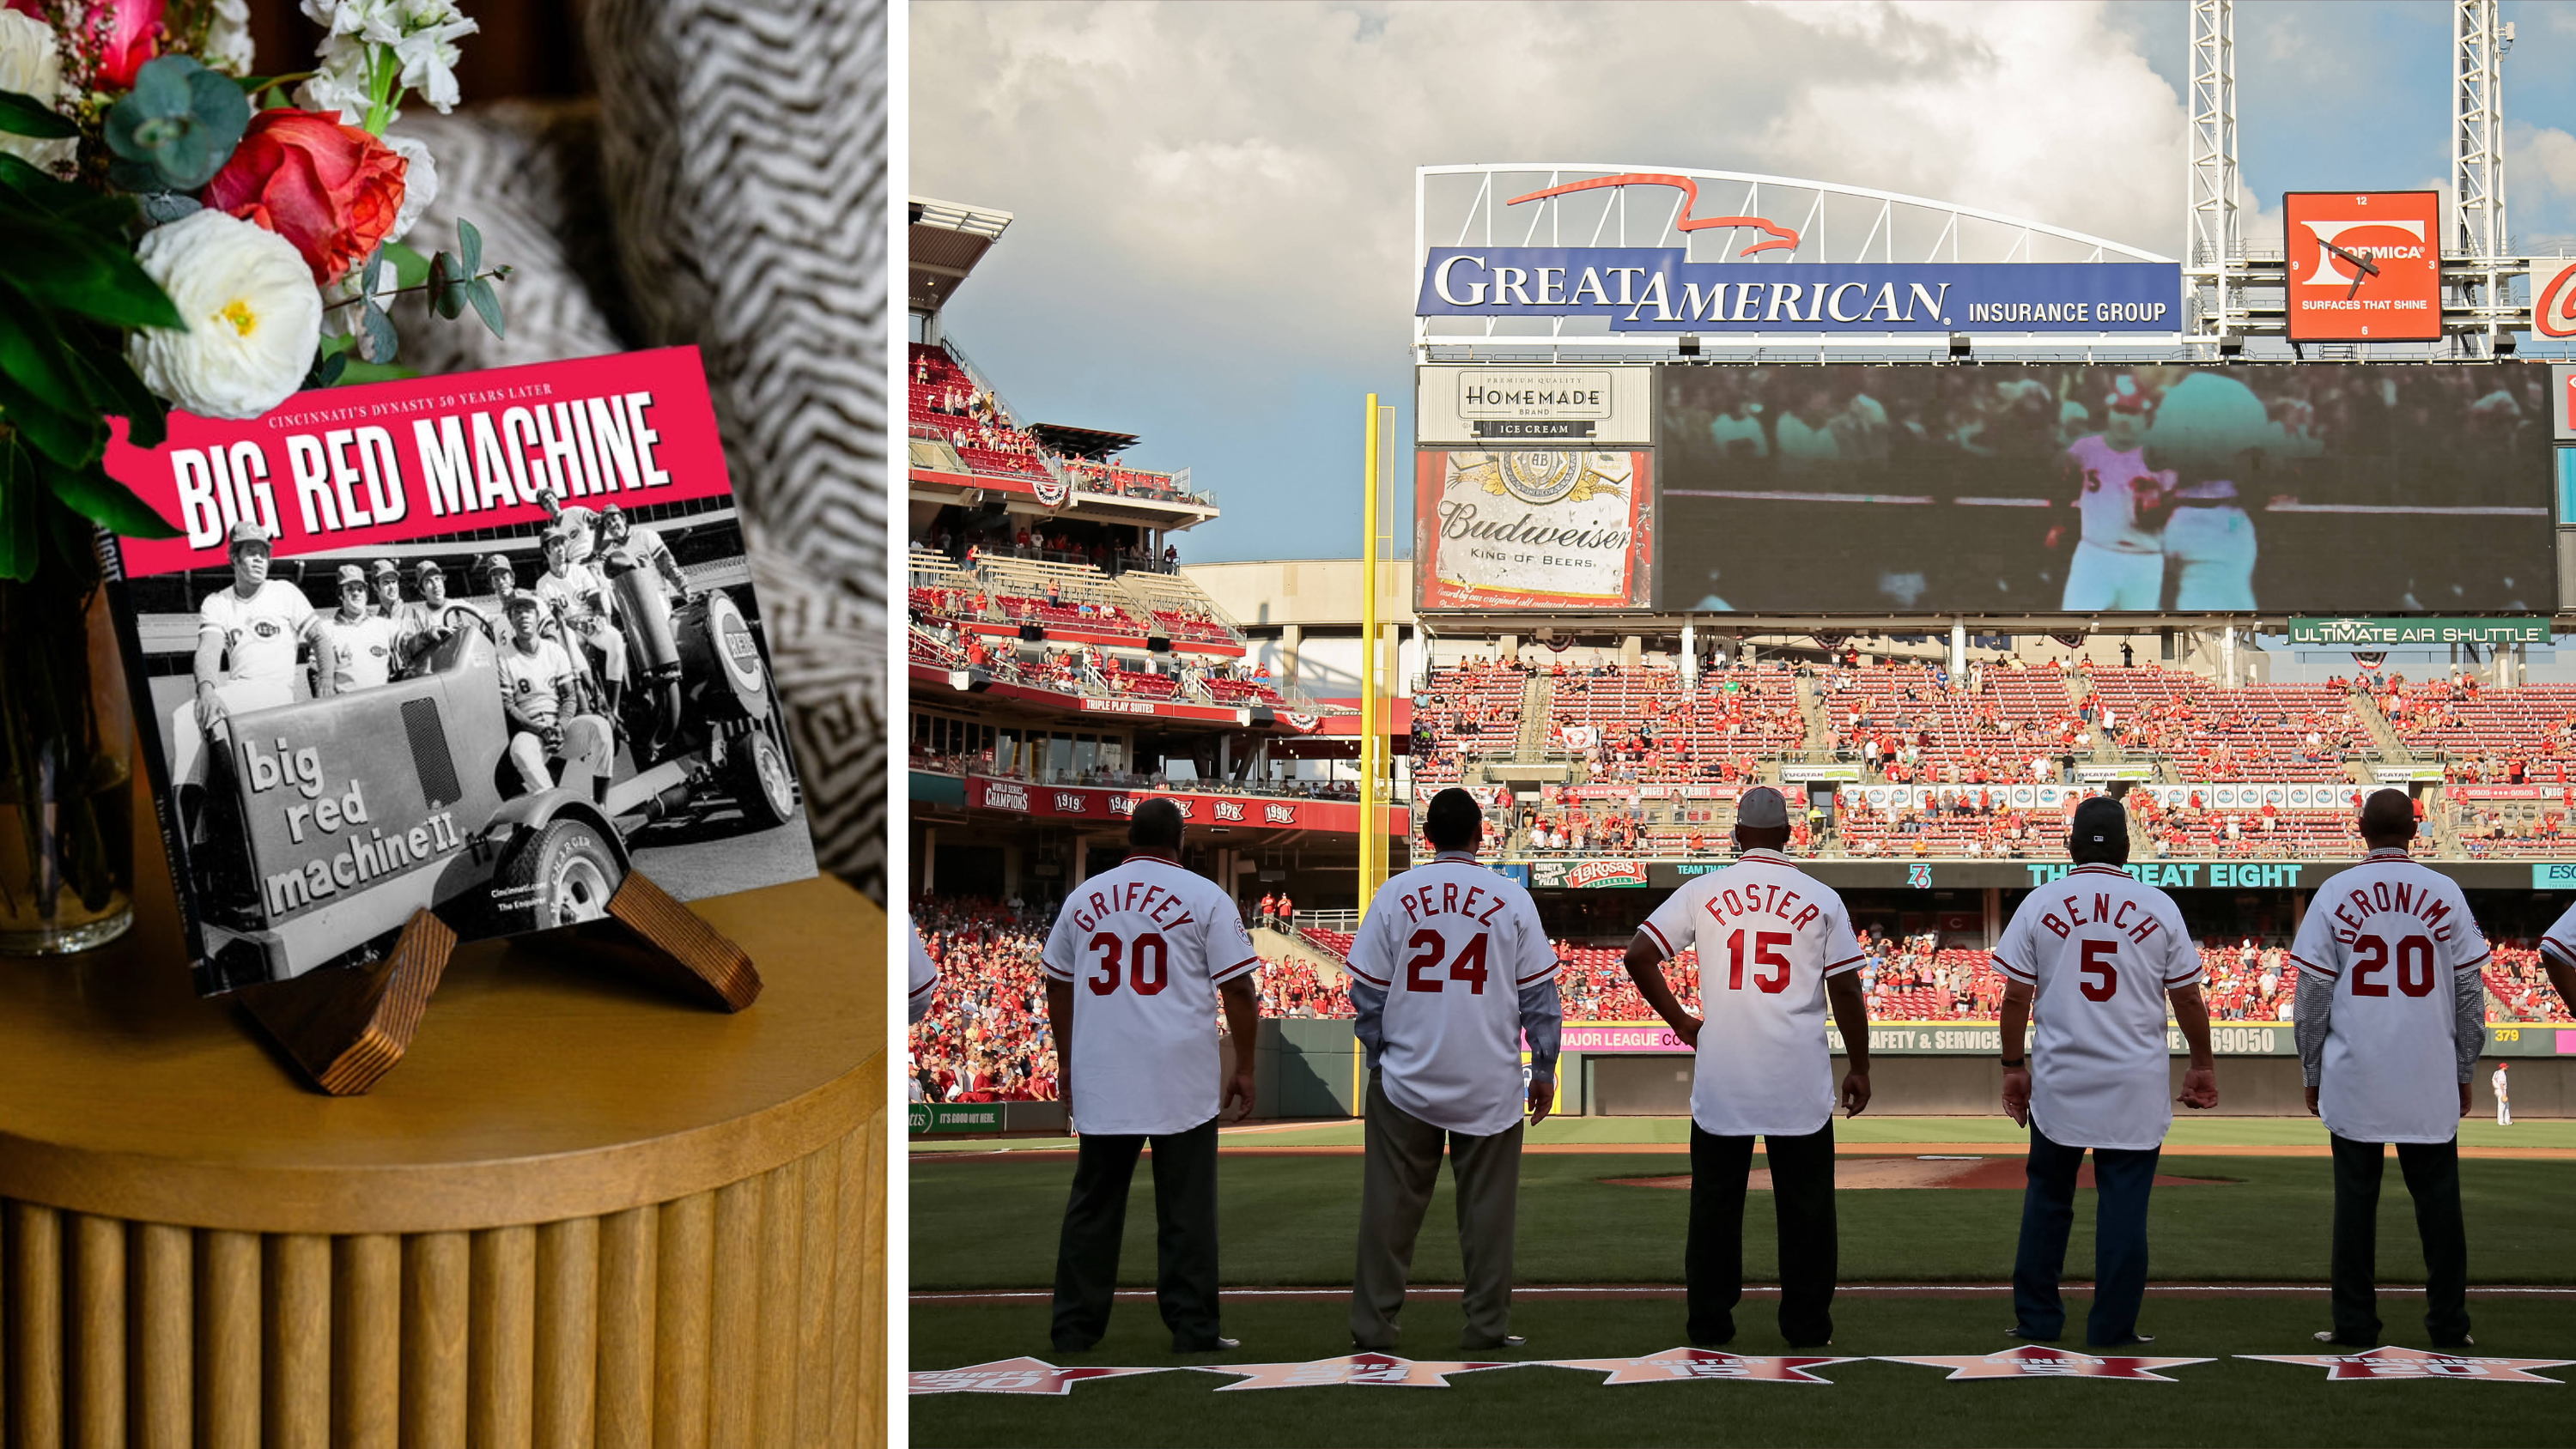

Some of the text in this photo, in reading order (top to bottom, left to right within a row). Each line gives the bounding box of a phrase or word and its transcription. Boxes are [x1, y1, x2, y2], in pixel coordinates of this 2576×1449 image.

[2355, 197, 2367, 205] 12
[2292, 261, 2300, 270] 9
[2428, 260, 2436, 270] 3
[1434, 254, 2167, 323] GREAT AMERICAN INSURANCE GROUP
[2301, 300, 2427, 310] SURFACES THAT SHINE
[2360, 326, 2368, 336] 6
[1466, 385, 1600, 405] HOMEMADE
[268, 383, 553, 428] CINCINNATI'S DYNASTY 50 YEARS LATER
[1500, 425, 1569, 433] ICE CREAM
[170, 391, 673, 549] BIG RED MACHINE
[1439, 500, 1632, 549] Budweiser
[1471, 548, 1506, 561] KING
[1514, 555, 1534, 563] OF
[1459, 589, 1469, 603] by
[1484, 594, 1520, 606] original
[2294, 627, 2540, 642] ULTIMATE AIR SHUTTLE
[1085, 699, 1155, 714] TRIPLE PLAY SUITES
[242, 737, 325, 799] big
[992, 782, 1024, 795] WORLD SERIES
[986, 787, 1028, 811] CHAMPIONS
[1056, 794, 1080, 810] 1919
[1110, 797, 1133, 813] 1940
[284, 779, 368, 845] red
[1215, 803, 1238, 818] 1976
[1266, 805, 1288, 822] 1990
[264, 827, 430, 917] machine
[1534, 867, 1567, 881] Original
[1535, 863, 1563, 871] CINCY'S
[1677, 864, 1704, 875] TEAM
[1539, 877, 1559, 886] PIZZA
[2123, 864, 2200, 887] REAT
[2210, 864, 2303, 887] EIGHT
[1074, 882, 1194, 933] GRIFFEY
[1400, 882, 1506, 928] PEREZ
[1704, 883, 1820, 932] FOSTER
[2331, 881, 2451, 945] GERONIMO
[2041, 892, 2160, 945] BENCH
[1088, 931, 1168, 996] 30
[1406, 928, 1489, 996] 24
[1726, 928, 1793, 994] 15
[2351, 934, 2435, 997] 20
[2080, 938, 2118, 1003] 5
[1605, 1033, 1660, 1046] LEAGUE
[1868, 1030, 1917, 1049] AFETY
[1919, 1032, 1932, 1049] &
[1935, 1030, 2001, 1050] SERVICE
[2210, 1028, 2275, 1053] 69050
[2494, 1029, 2520, 1042] 379
[939, 1113, 951, 1124] IT'S
[951, 1113, 969, 1124] GOOD
[969, 1113, 980, 1124] OUT
[913, 1369, 1073, 1379] GRIFFEY
[1283, 1369, 1410, 1383] 24
[1660, 1364, 1751, 1376] 15
[2020, 1364, 2080, 1373] 5
[2363, 1363, 2491, 1375] 20
[910, 1377, 1042, 1390] 30
